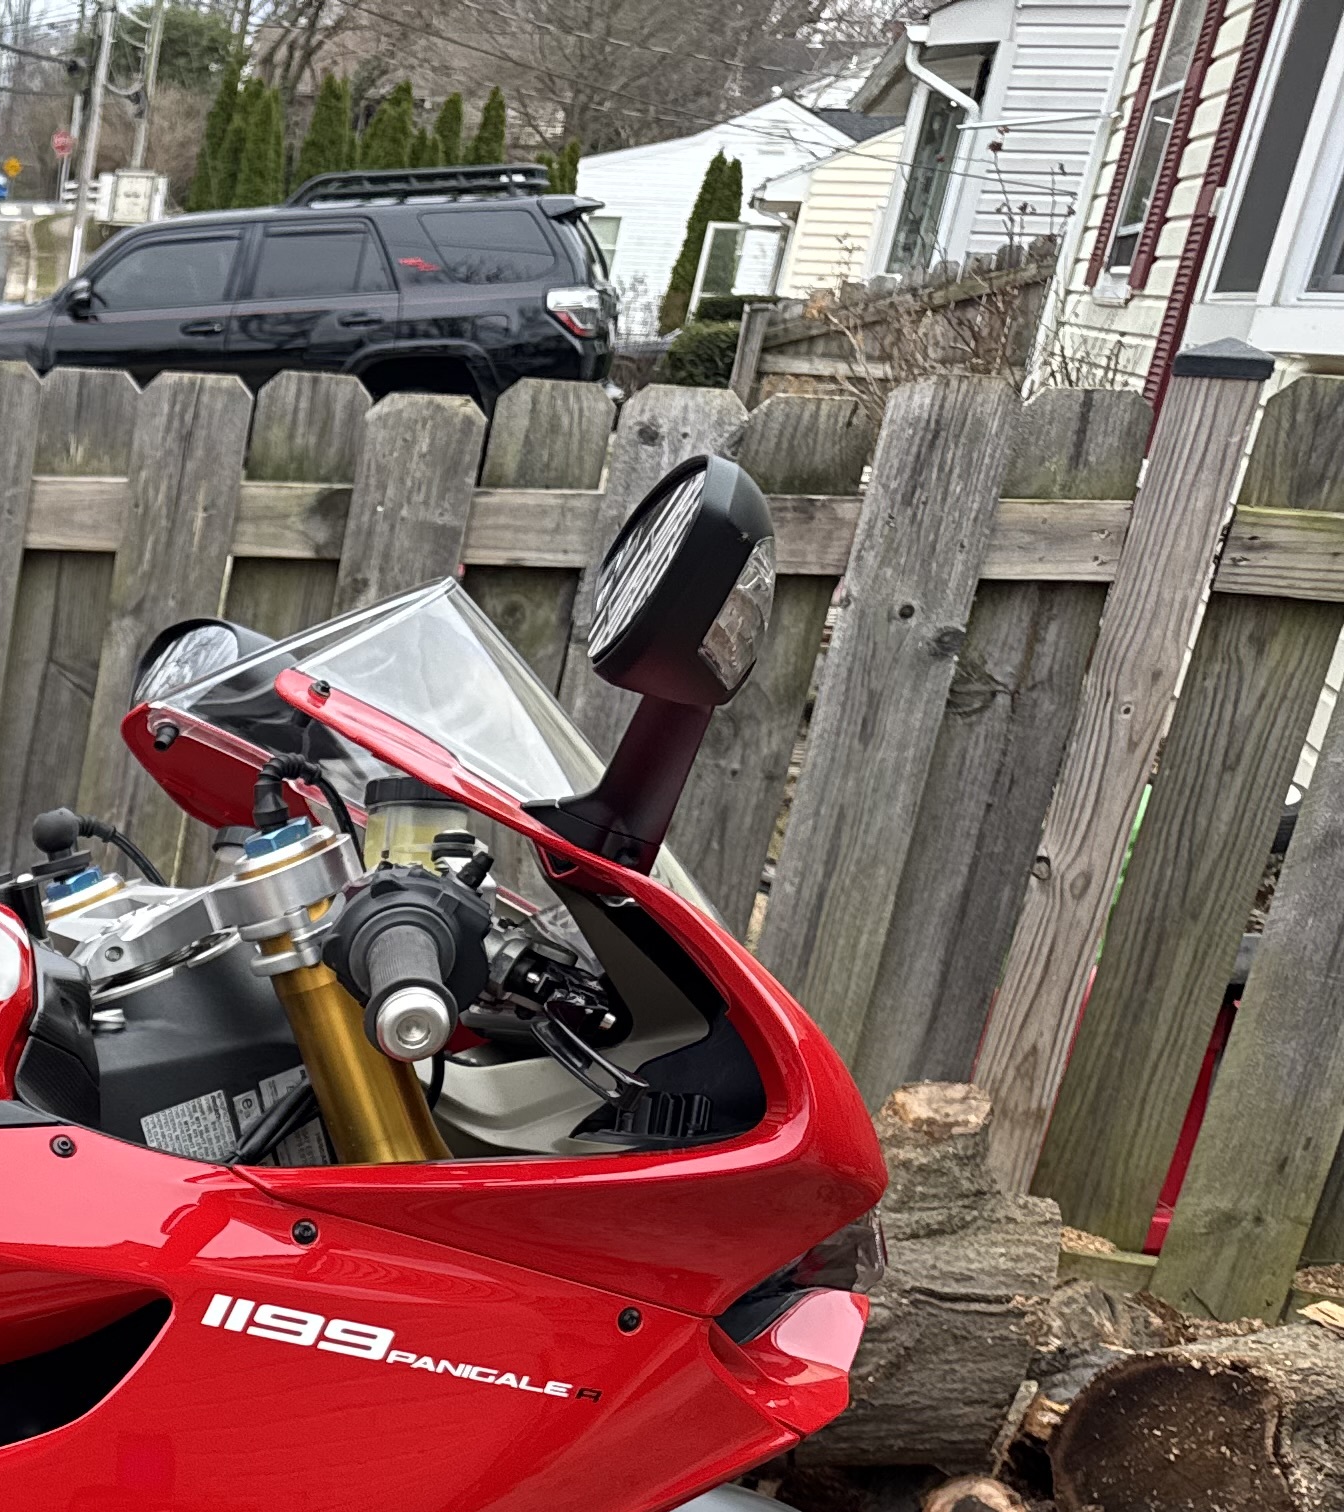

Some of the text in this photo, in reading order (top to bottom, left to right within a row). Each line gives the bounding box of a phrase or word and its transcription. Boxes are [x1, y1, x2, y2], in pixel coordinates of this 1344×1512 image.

[201, 1293, 603, 1403] 1199 PANIGALE R
